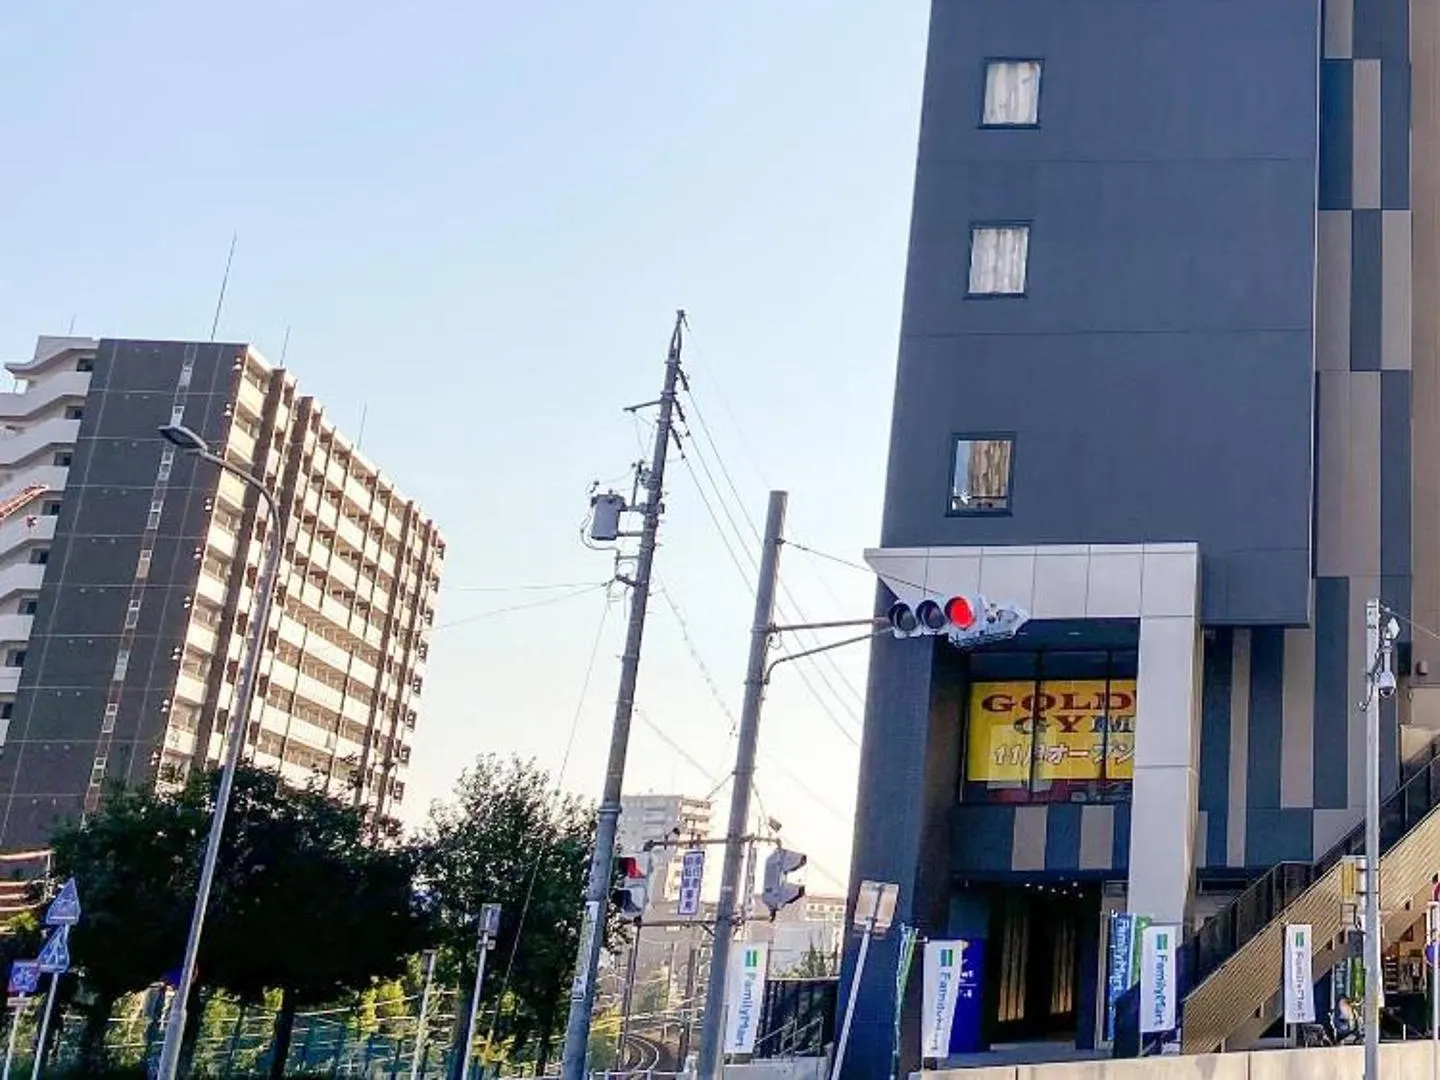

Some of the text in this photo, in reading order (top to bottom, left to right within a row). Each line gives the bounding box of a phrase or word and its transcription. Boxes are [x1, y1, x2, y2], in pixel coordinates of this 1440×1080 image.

[1013, 715, 1134, 735] GYM
[736, 971, 756, 1048] FamilyMart
[1154, 953, 1168, 1025] FamilyMart
